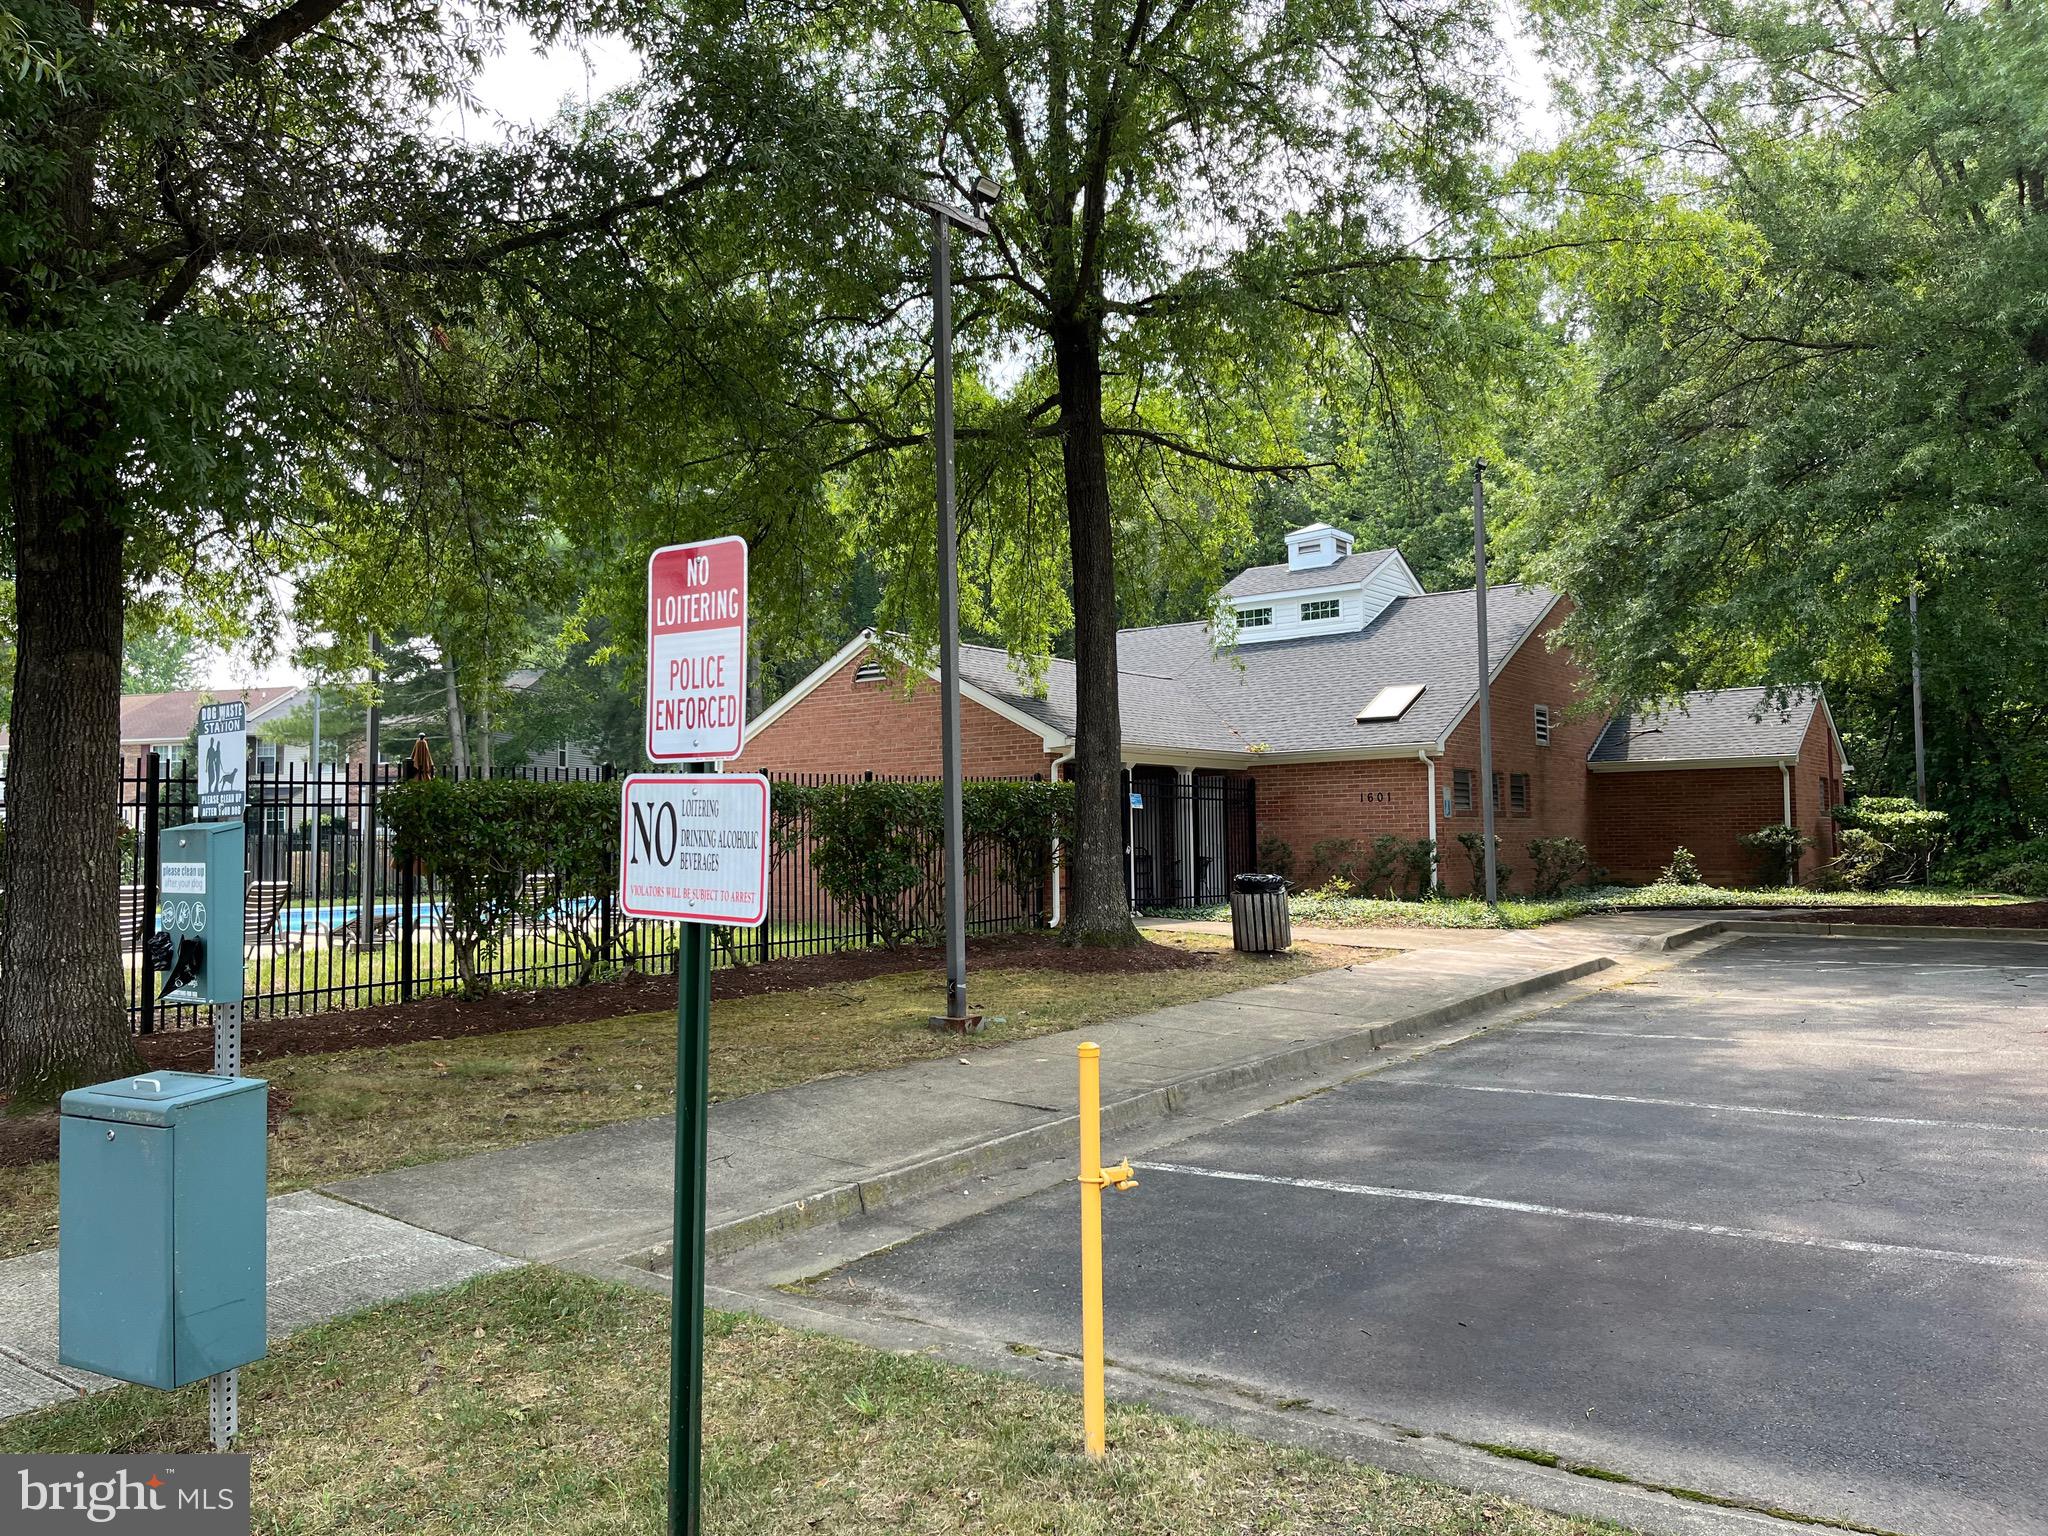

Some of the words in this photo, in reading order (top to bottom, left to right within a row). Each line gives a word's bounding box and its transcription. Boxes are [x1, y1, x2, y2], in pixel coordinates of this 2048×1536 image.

[687, 556, 709, 587] NO
[656, 588, 739, 626] LOITERING
[670, 655, 725, 691] POLICE
[201, 706, 217, 720] DOG
[219, 703, 242, 719] WASTE
[655, 694, 737, 731] ENFORCED
[204, 720, 240, 734] STATION
[201, 795, 219, 804] PLEASE
[220, 794, 234, 803] CLEAN
[235, 793, 242, 803] UP
[1360, 792, 1391, 803] 1601
[202, 807, 217, 817] AFTER
[231, 805, 241, 816] DOG
[682, 800, 719, 817] LOITERING
[630, 801, 678, 867] NO
[681, 830, 717, 848] DRINKING
[719, 831, 758, 849] ALCOHOLIC
[680, 853, 719, 871] BEVERAGES
[162, 866, 180, 877] please
[181, 865, 196, 877] clean
[197, 867, 205, 877] up
[164, 878, 178, 888] after
[178, 880, 190, 889] your
[191, 878, 203, 891] dog
[630, 885, 664, 897] VIOLATORS
[666, 887, 682, 899] WILL
[683, 888, 691, 899] BE
[692, 889, 718, 902] SUBJECT
[720, 890, 731, 900] TO
[731, 892, 757, 904] ARREST
